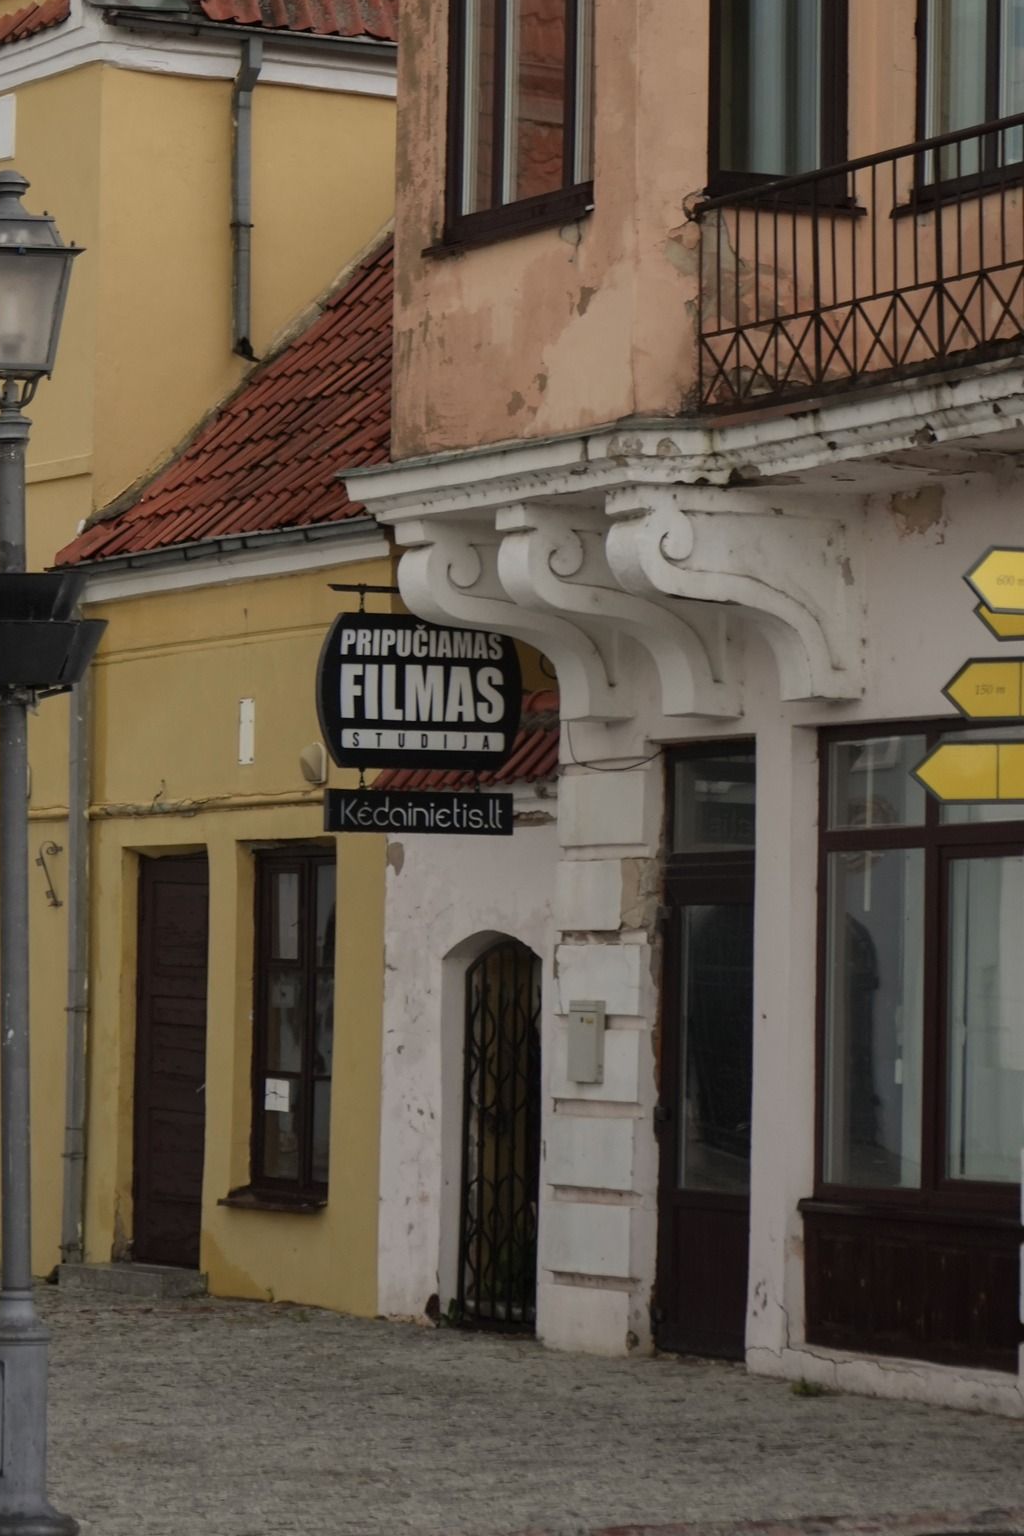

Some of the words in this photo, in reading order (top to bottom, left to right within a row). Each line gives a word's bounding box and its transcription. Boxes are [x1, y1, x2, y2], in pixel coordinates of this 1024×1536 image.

[340, 623, 504, 661] PRIPUČIAMAS
[340, 663, 505, 724] FILMAS
[352, 731, 490, 751] STUDIJA
[340, 796, 503, 829] Kėdainietis.lt
